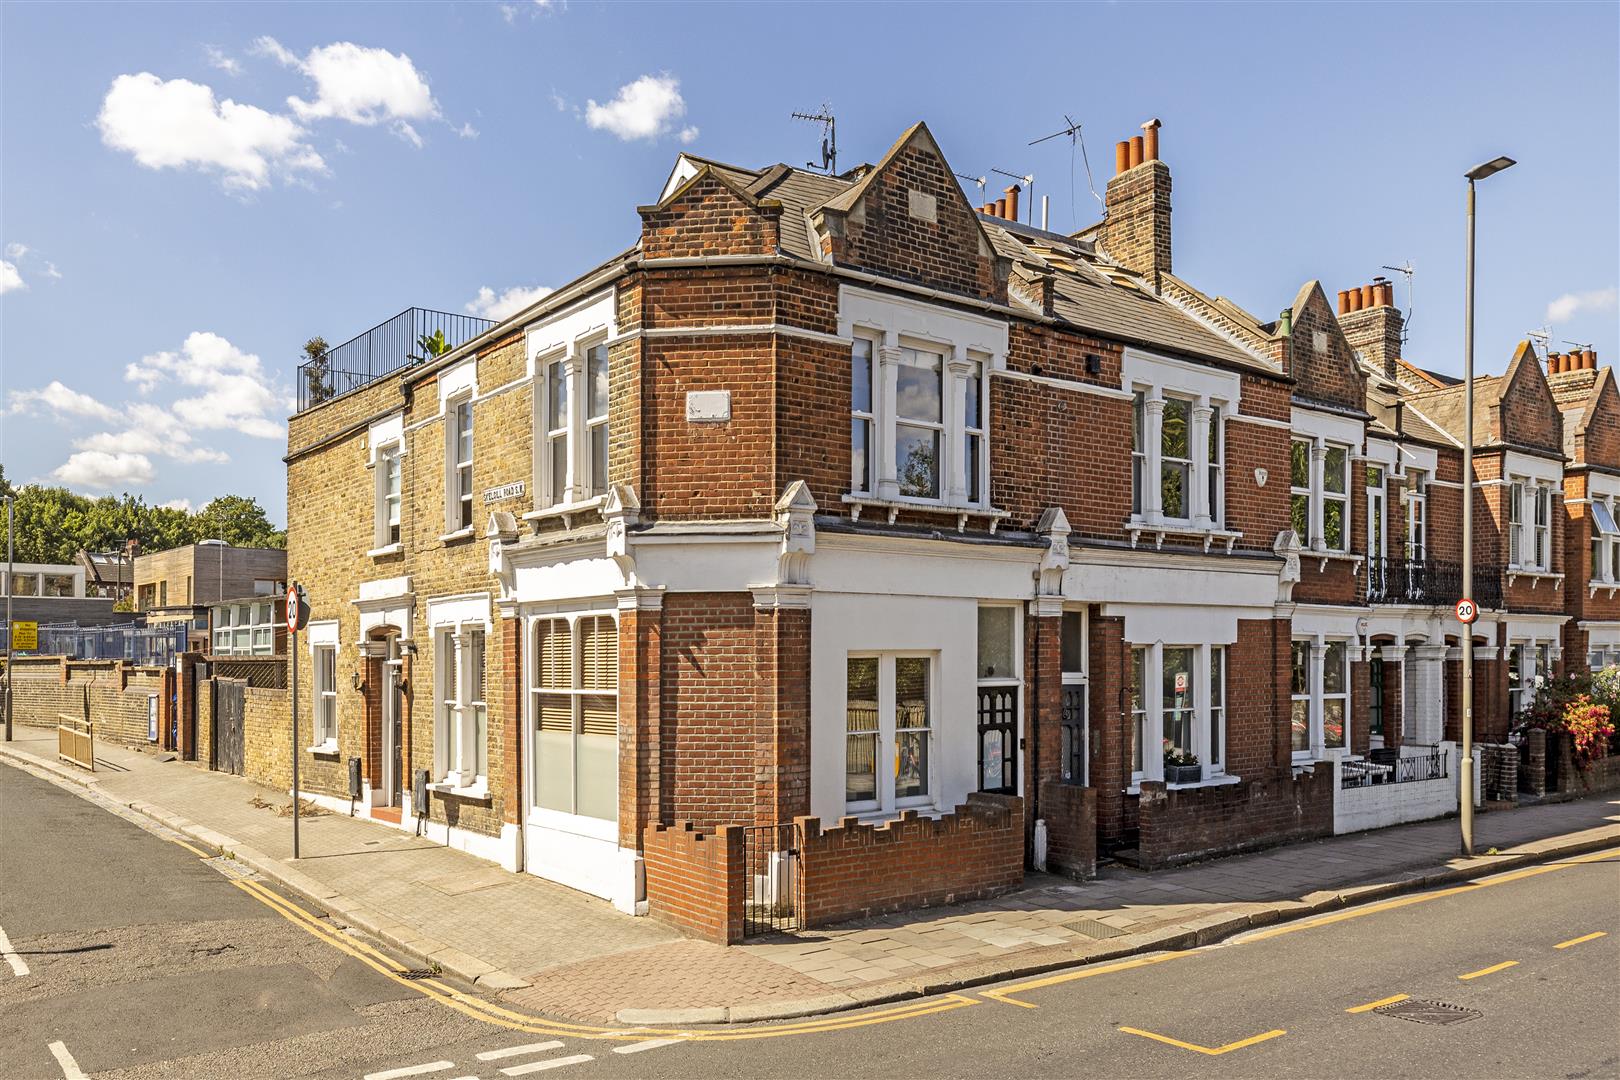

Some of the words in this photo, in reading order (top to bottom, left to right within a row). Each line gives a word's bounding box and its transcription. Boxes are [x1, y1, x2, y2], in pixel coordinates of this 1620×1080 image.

[503, 486, 515, 498] ROAD
[288, 600, 296, 618] 20
[1459, 605, 1472, 615] 20
